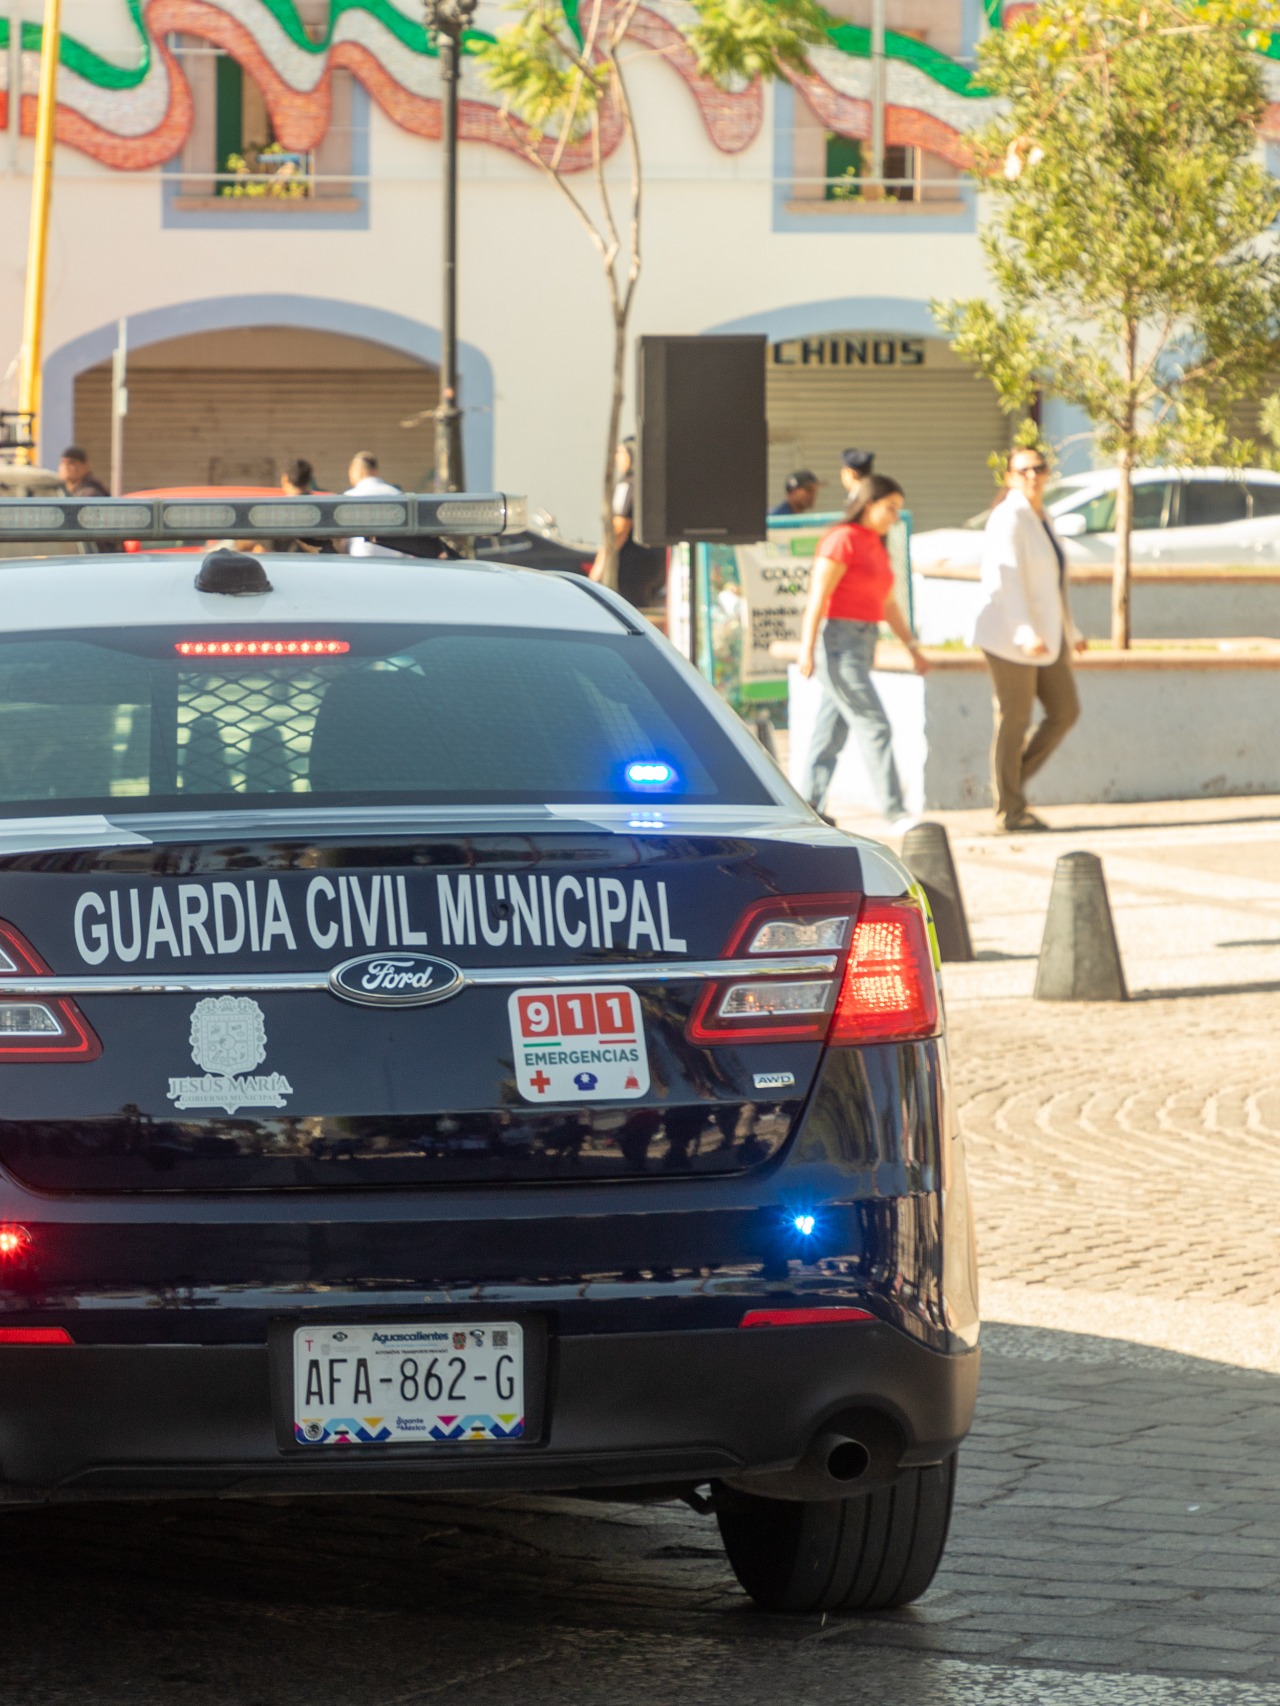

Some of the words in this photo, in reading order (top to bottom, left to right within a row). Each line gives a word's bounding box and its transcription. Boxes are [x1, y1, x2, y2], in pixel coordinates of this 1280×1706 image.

[773, 339, 926, 365] CHINOS
[74, 878, 296, 965] GUARDIA
[306, 875, 428, 950] CIVIL
[437, 874, 687, 953] MUNICIPAL
[361, 960, 433, 989] Ford
[527, 998, 623, 1032] 911
[524, 1049, 639, 1066] EMERGENCIAS
[170, 1075, 222, 1095] JESÚS
[229, 1074, 290, 1094] MARÍA
[372, 1331, 448, 1344] Aguascalientes
[306, 1355, 514, 1405] AFA-862-G
